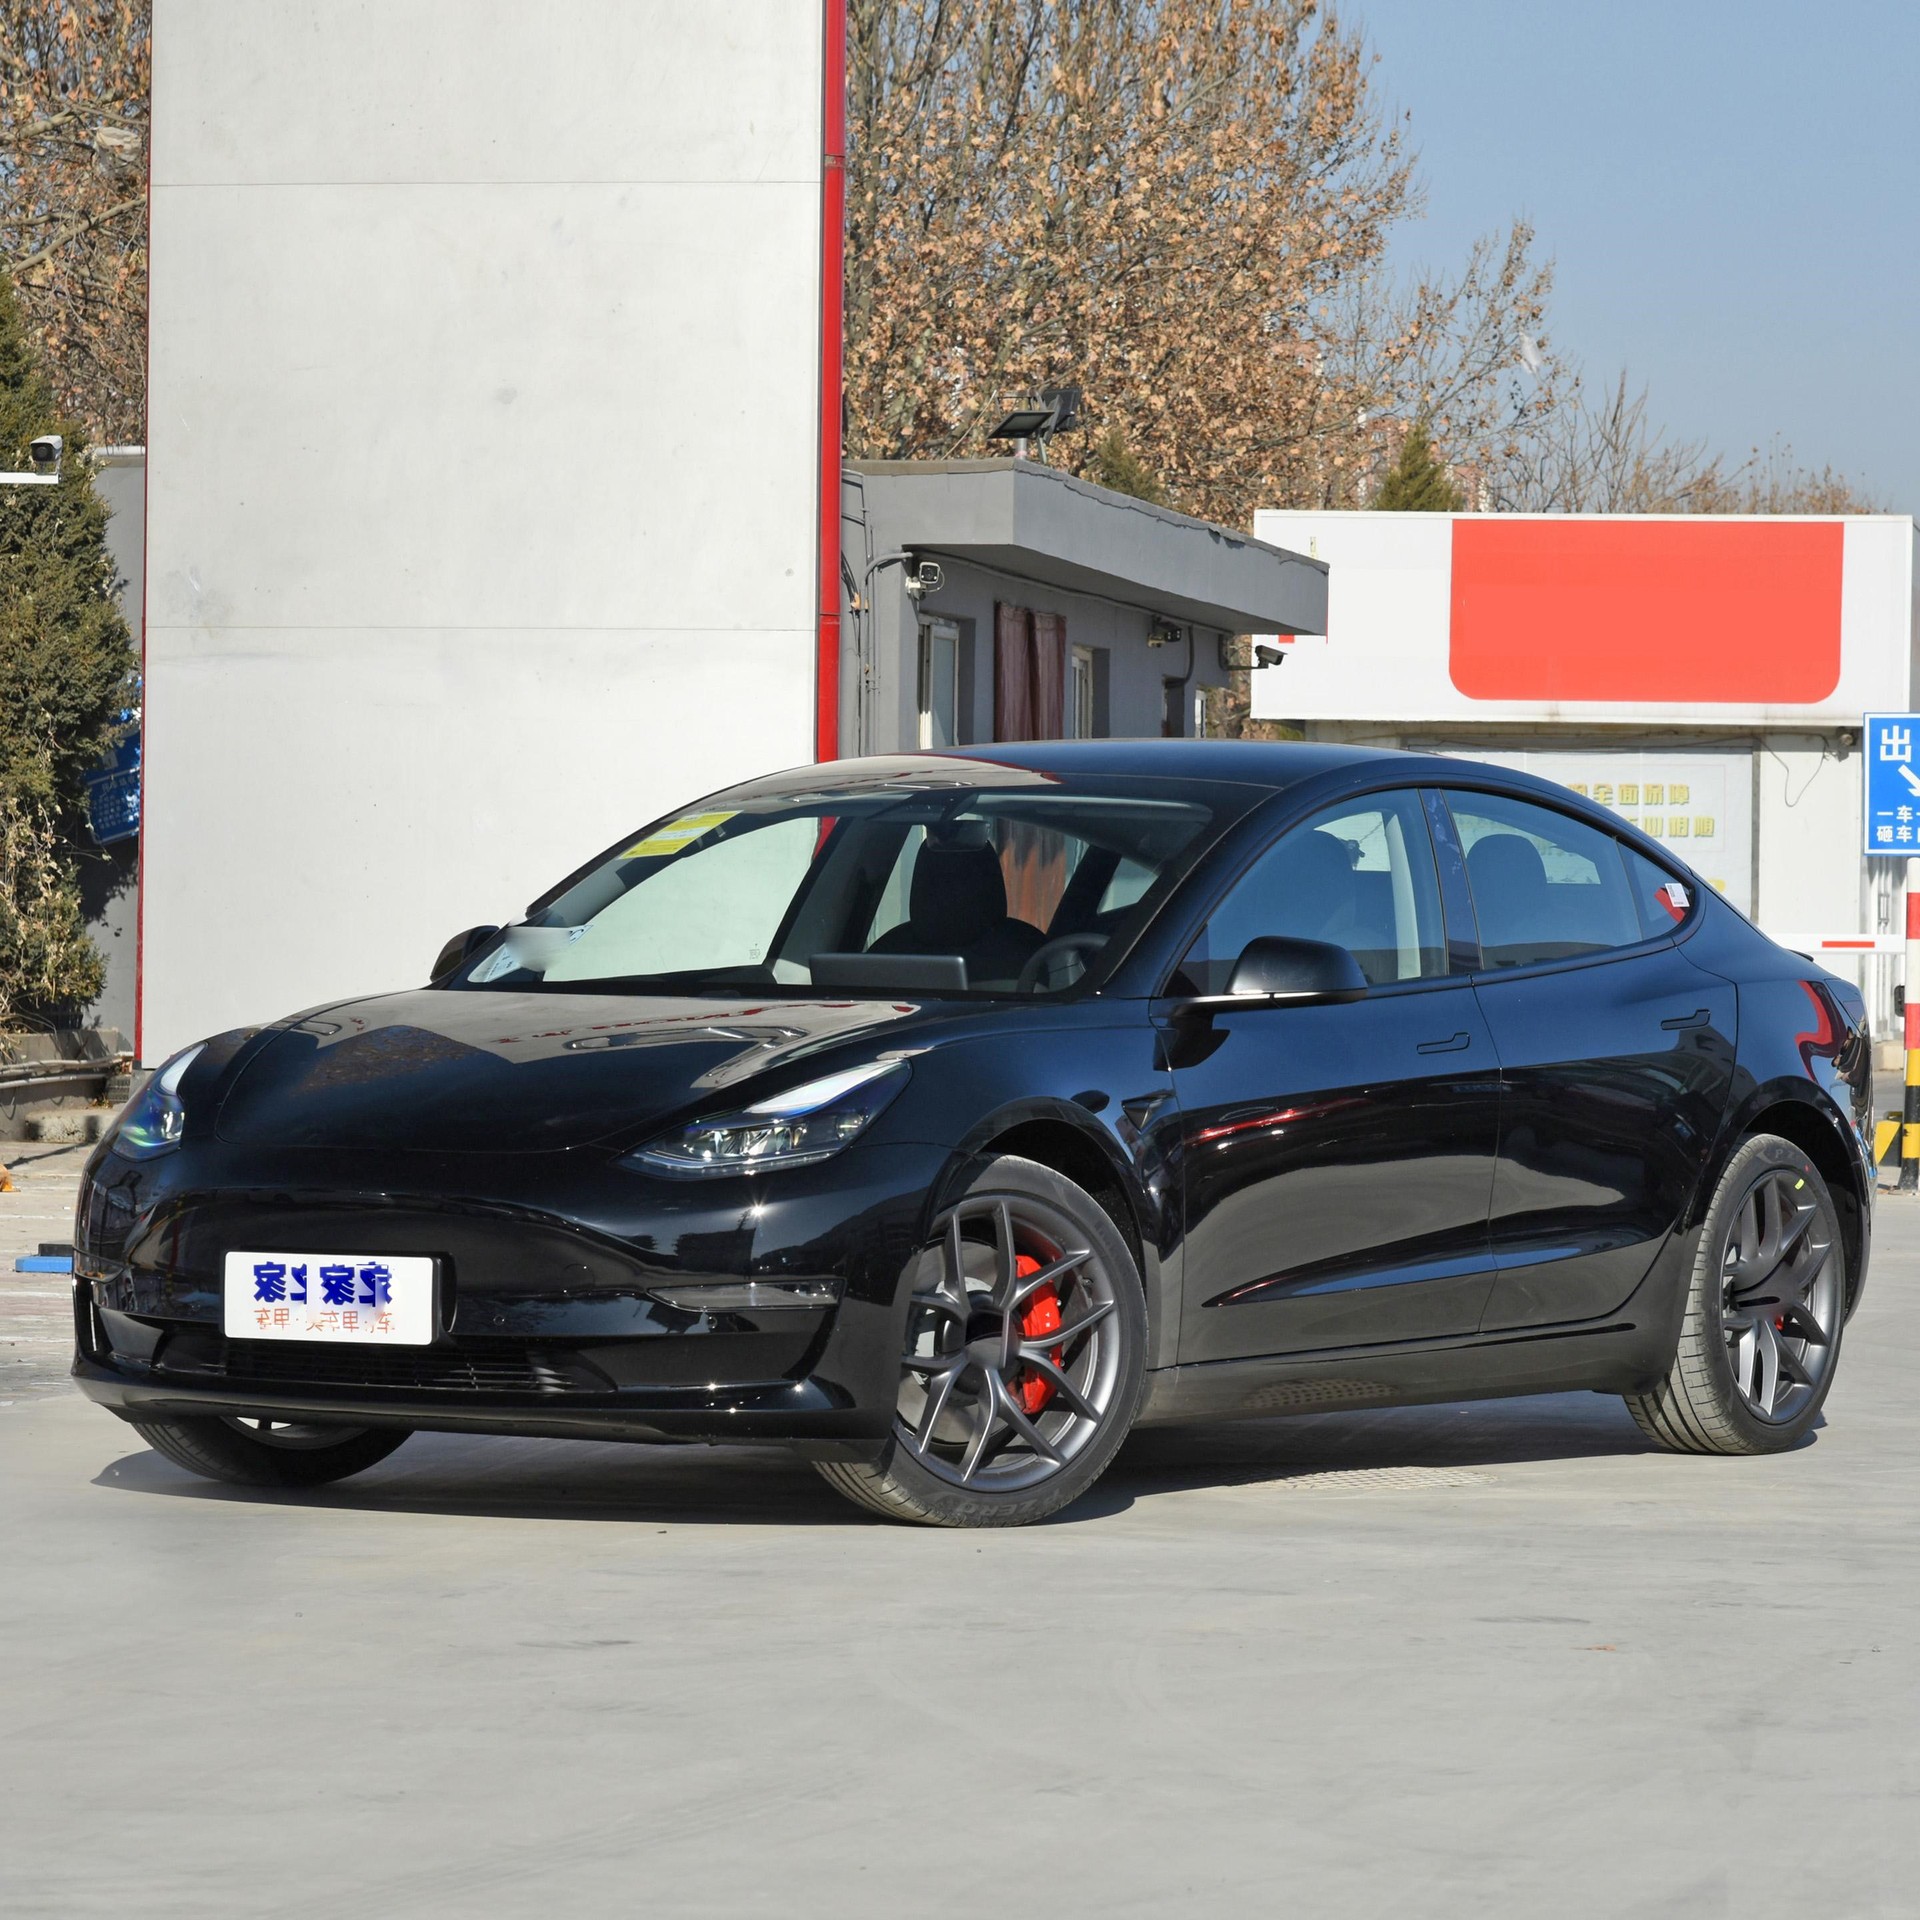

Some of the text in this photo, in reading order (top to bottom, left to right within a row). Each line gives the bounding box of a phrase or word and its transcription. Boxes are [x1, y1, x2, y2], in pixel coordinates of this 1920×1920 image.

[1880, 725, 1912, 763] 出
[1877, 804, 1920, 823] 一车
[1876, 825, 1920, 843] 砸车
